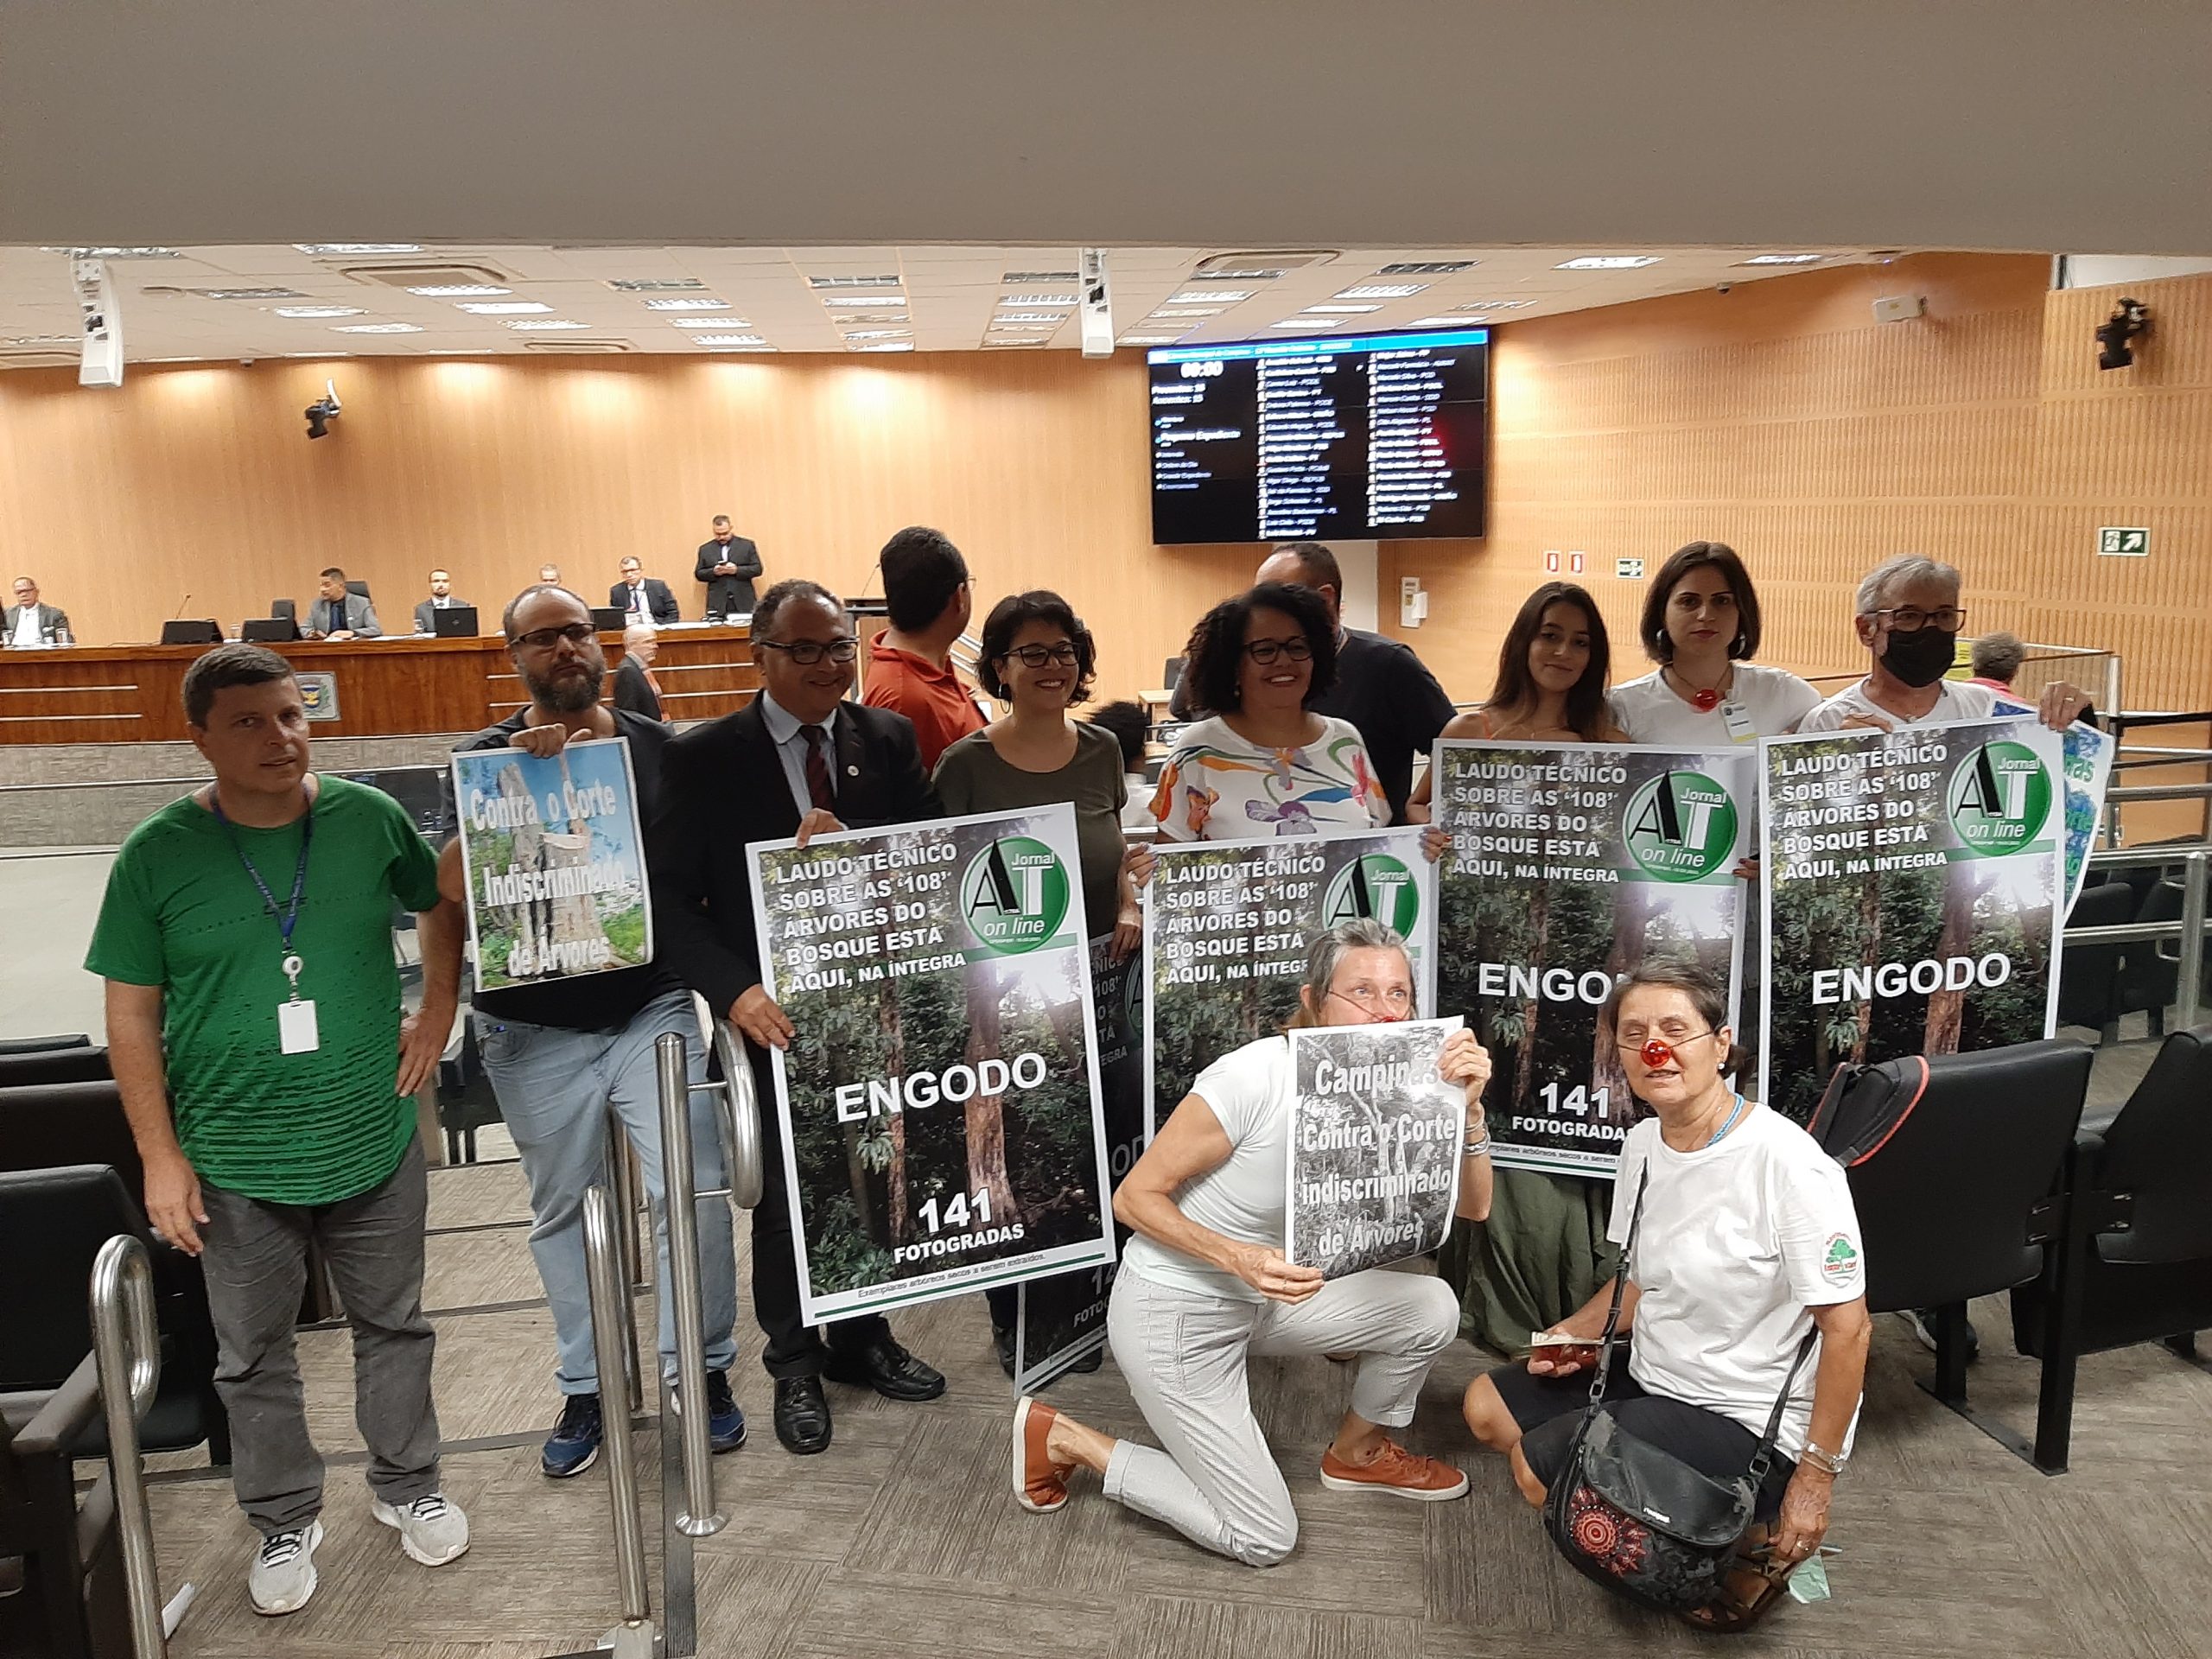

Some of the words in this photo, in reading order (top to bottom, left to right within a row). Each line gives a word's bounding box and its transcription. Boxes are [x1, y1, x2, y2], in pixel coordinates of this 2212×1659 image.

[1455, 764, 1525, 780] LAUDO
[1532, 760, 1627, 784] TÉCNICO
[1781, 756, 1850, 777] LAUDO
[1859, 743, 1948, 767] TÉCNICO
[1997, 757, 2040, 771] Jornal
[1454, 785, 1523, 805] SOBRE
[1530, 791, 1557, 807] AS
[1680, 787, 1727, 804] Jornal
[1782, 779, 1852, 803] SOBRE
[1858, 777, 1885, 796] AS
[470, 788, 537, 831] Contra
[547, 792, 559, 822] o
[563, 779, 616, 821] Corte
[1783, 803, 1879, 829] ÁRVORES
[1885, 802, 1914, 818] DO
[1454, 808, 1551, 830] ÁRVORES
[1556, 816, 1586, 832] DO
[1967, 823, 1988, 839] on
[1993, 820, 2026, 838] line
[1453, 835, 1538, 855] BOSQUE
[1545, 836, 1600, 858] ESTÁ
[1783, 830, 1869, 855] BOSQUE
[1874, 823, 1928, 846] ESTÁ
[777, 856, 851, 884] LAUDO
[864, 843, 957, 872] TÉCNICO
[1012, 851, 1054, 866] Jornal
[1166, 862, 1233, 884] LAUDO
[1243, 855, 1326, 877] TÉCNICO
[1452, 857, 1509, 880] AQUI,
[1515, 864, 1539, 879] NA
[1543, 861, 1619, 883] ÍNTEGRA
[1642, 848, 1666, 863] on
[1669, 848, 1705, 868] line
[1784, 858, 1840, 880] AQUI,
[1847, 857, 1870, 874] NA
[1874, 848, 1948, 872] ÍNTEGRA
[1371, 868, 1410, 880] Jornal
[779, 881, 858, 912] SOBRE
[863, 876, 892, 899] AS
[1167, 887, 1233, 909] SOBRE
[1237, 886, 1265, 903] AS
[783, 907, 889, 938] ÁRVORES
[895, 902, 925, 921] DO
[984, 922, 1007, 936] on
[1013, 917, 1045, 934] line
[1166, 910, 1259, 934] ÁRVORES
[1264, 908, 1292, 926] DO
[508, 940, 531, 976] de
[787, 935, 880, 966] BOSQUE
[886, 926, 943, 951] ESTÁ
[1166, 938, 1249, 959] BOSQUE
[1254, 930, 1304, 952] ESTÁ
[791, 967, 853, 993] AQUI,
[859, 966, 883, 982] NA
[887, 952, 967, 977] ÍNTEGRA
[1166, 964, 1222, 984] AQUI,
[1226, 963, 1249, 979] NA
[1253, 959, 1309, 977] ÍNTEG
[1478, 963, 1631, 1005] ENGO
[1813, 952, 2012, 1005] ENGODO
[835, 1052, 1047, 1123] ENGODO
[1540, 1082, 1609, 1119] 141
[1303, 1123, 1372, 1151] Contra
[1379, 1122, 1390, 1142] o
[1397, 1113, 1455, 1143] Corte
[1512, 1116, 1629, 1141] FOTOGRADA
[918, 1187, 993, 1234] 141
[893, 1223, 1025, 1265] FOTOGRADAS
[1319, 1219, 1344, 1256] de
